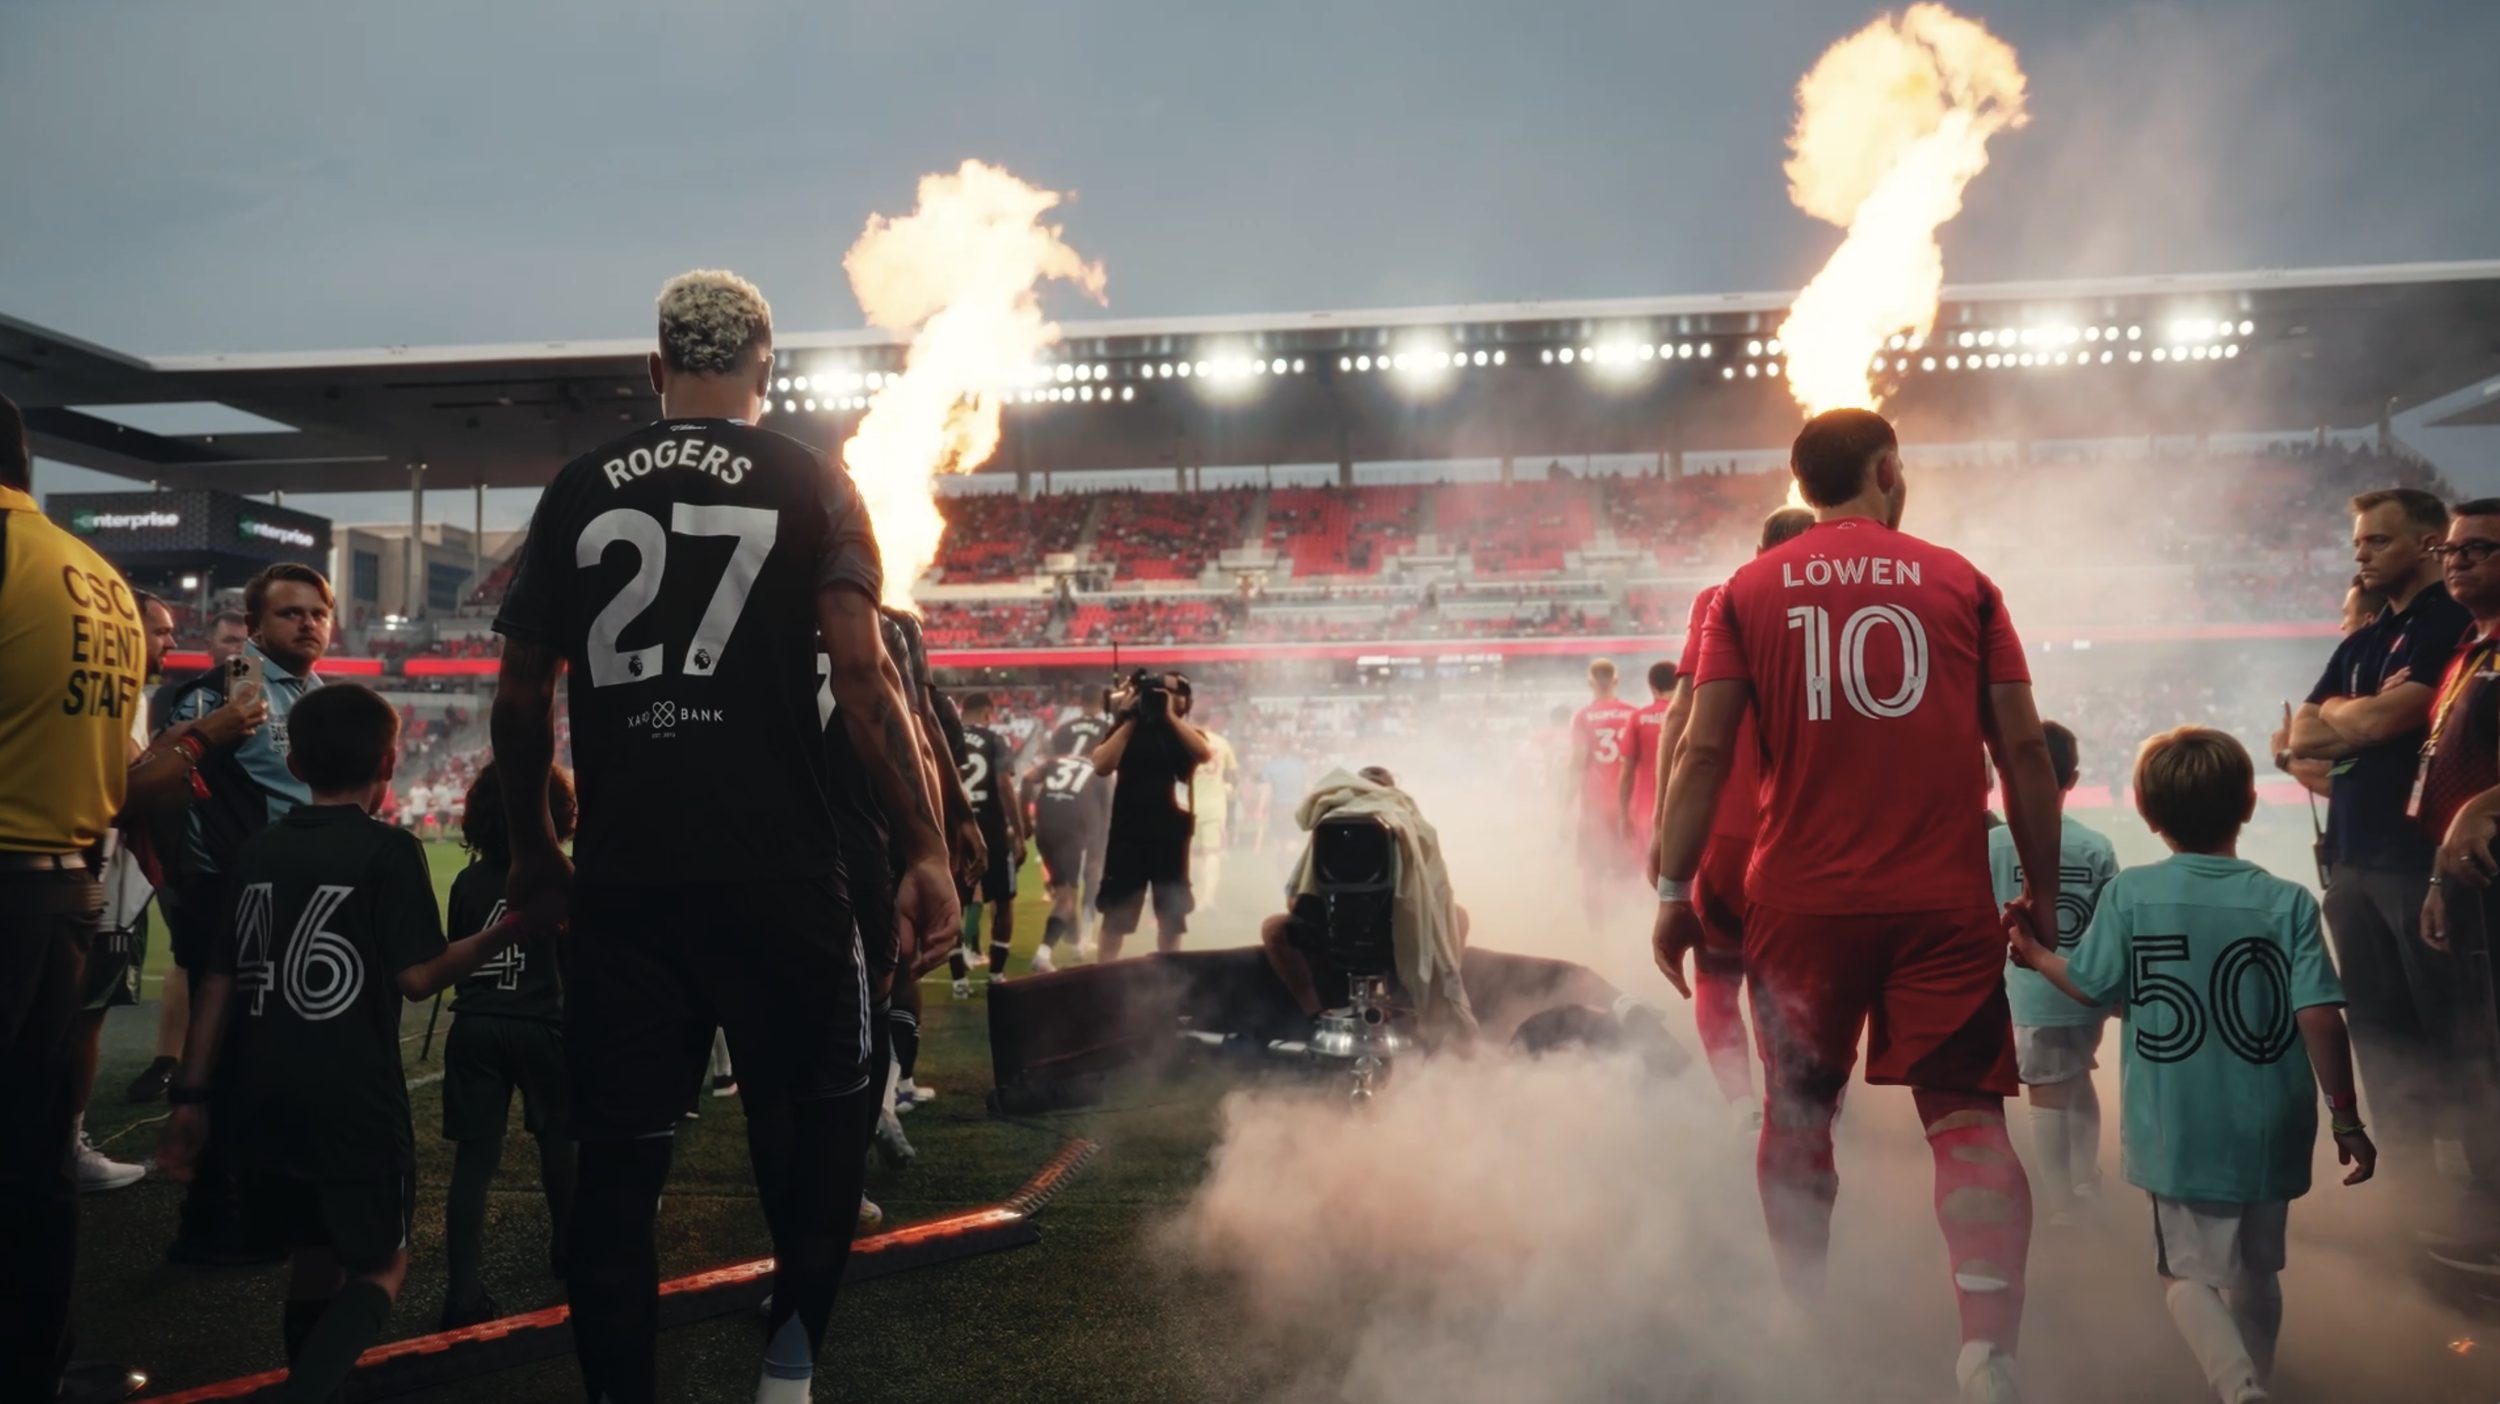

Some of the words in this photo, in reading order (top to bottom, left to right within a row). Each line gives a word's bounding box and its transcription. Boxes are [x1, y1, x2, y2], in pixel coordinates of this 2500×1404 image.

[603, 438, 752, 489] ROGERS
[73, 511, 180, 531] enterprise
[239, 519, 315, 547] enterprise
[63, 564, 135, 621] CSC
[575, 502, 779, 688] 27
[1782, 553, 1922, 589] LÖWEN
[72, 614, 141, 674] EVENT
[1787, 602, 1929, 721] 10
[63, 669, 138, 719] STAF
[681, 707, 724, 722] BANK
[1594, 727, 1626, 764] 3
[1046, 757, 1095, 794] 31
[235, 882, 365, 1021] 46
[2130, 934, 2300, 1065] 50
